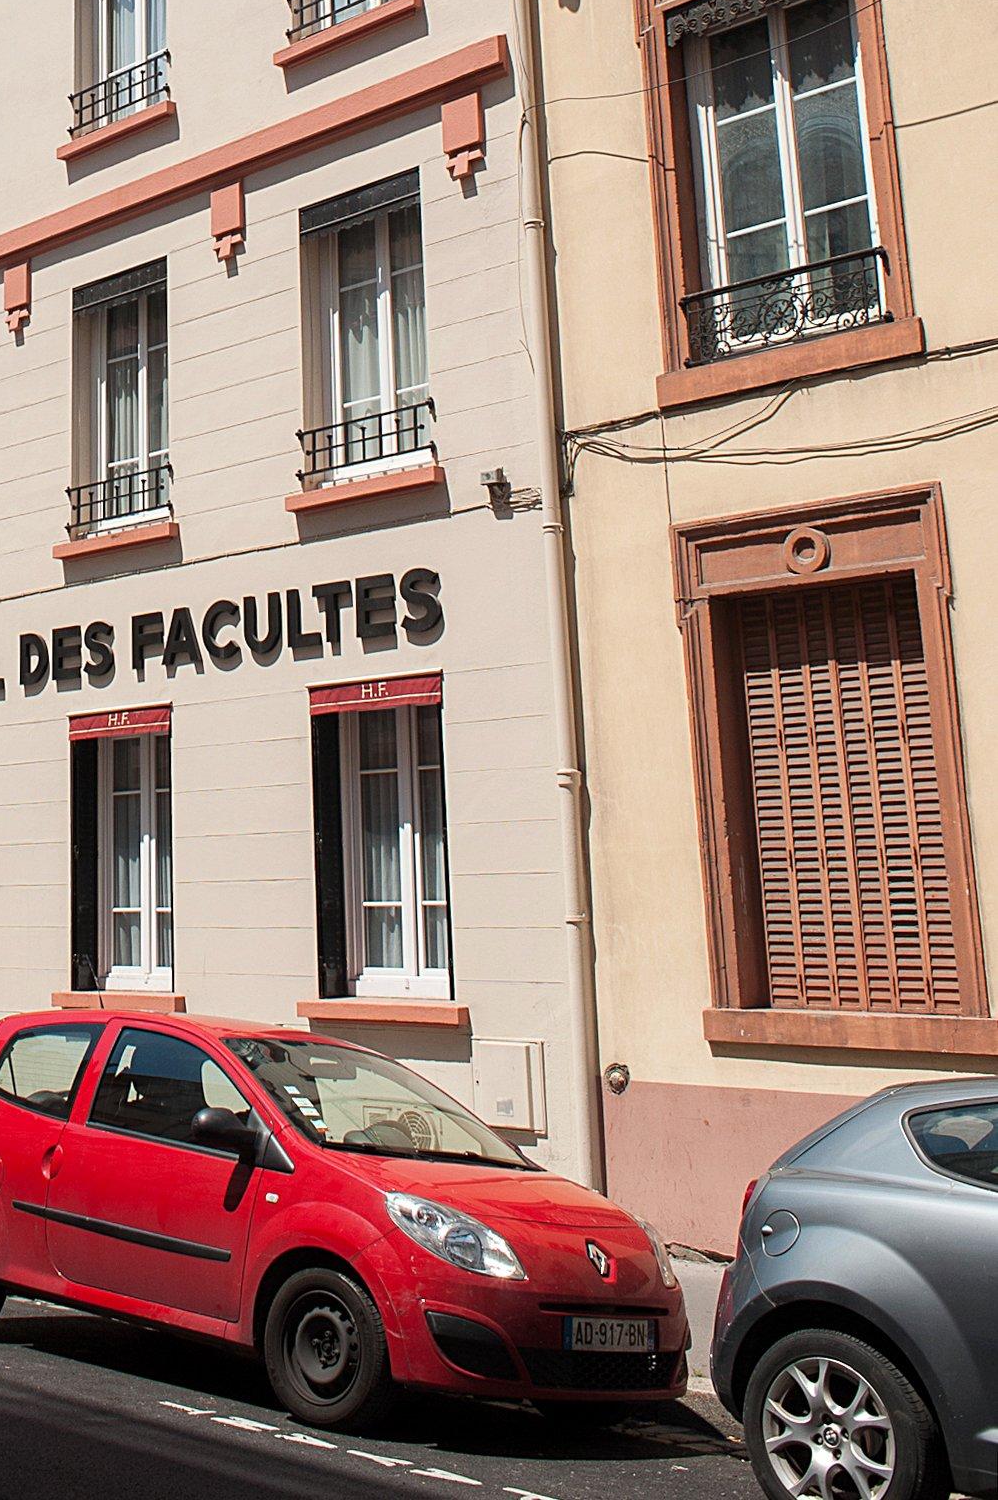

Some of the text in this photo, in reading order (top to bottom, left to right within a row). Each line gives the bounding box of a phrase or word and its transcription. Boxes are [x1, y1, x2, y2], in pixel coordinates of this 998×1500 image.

[19, 621, 115, 687] DES
[131, 567, 441, 671] FACULTES
[361, 681, 389, 699] H.F.
[107, 711, 130, 727] H.F.
